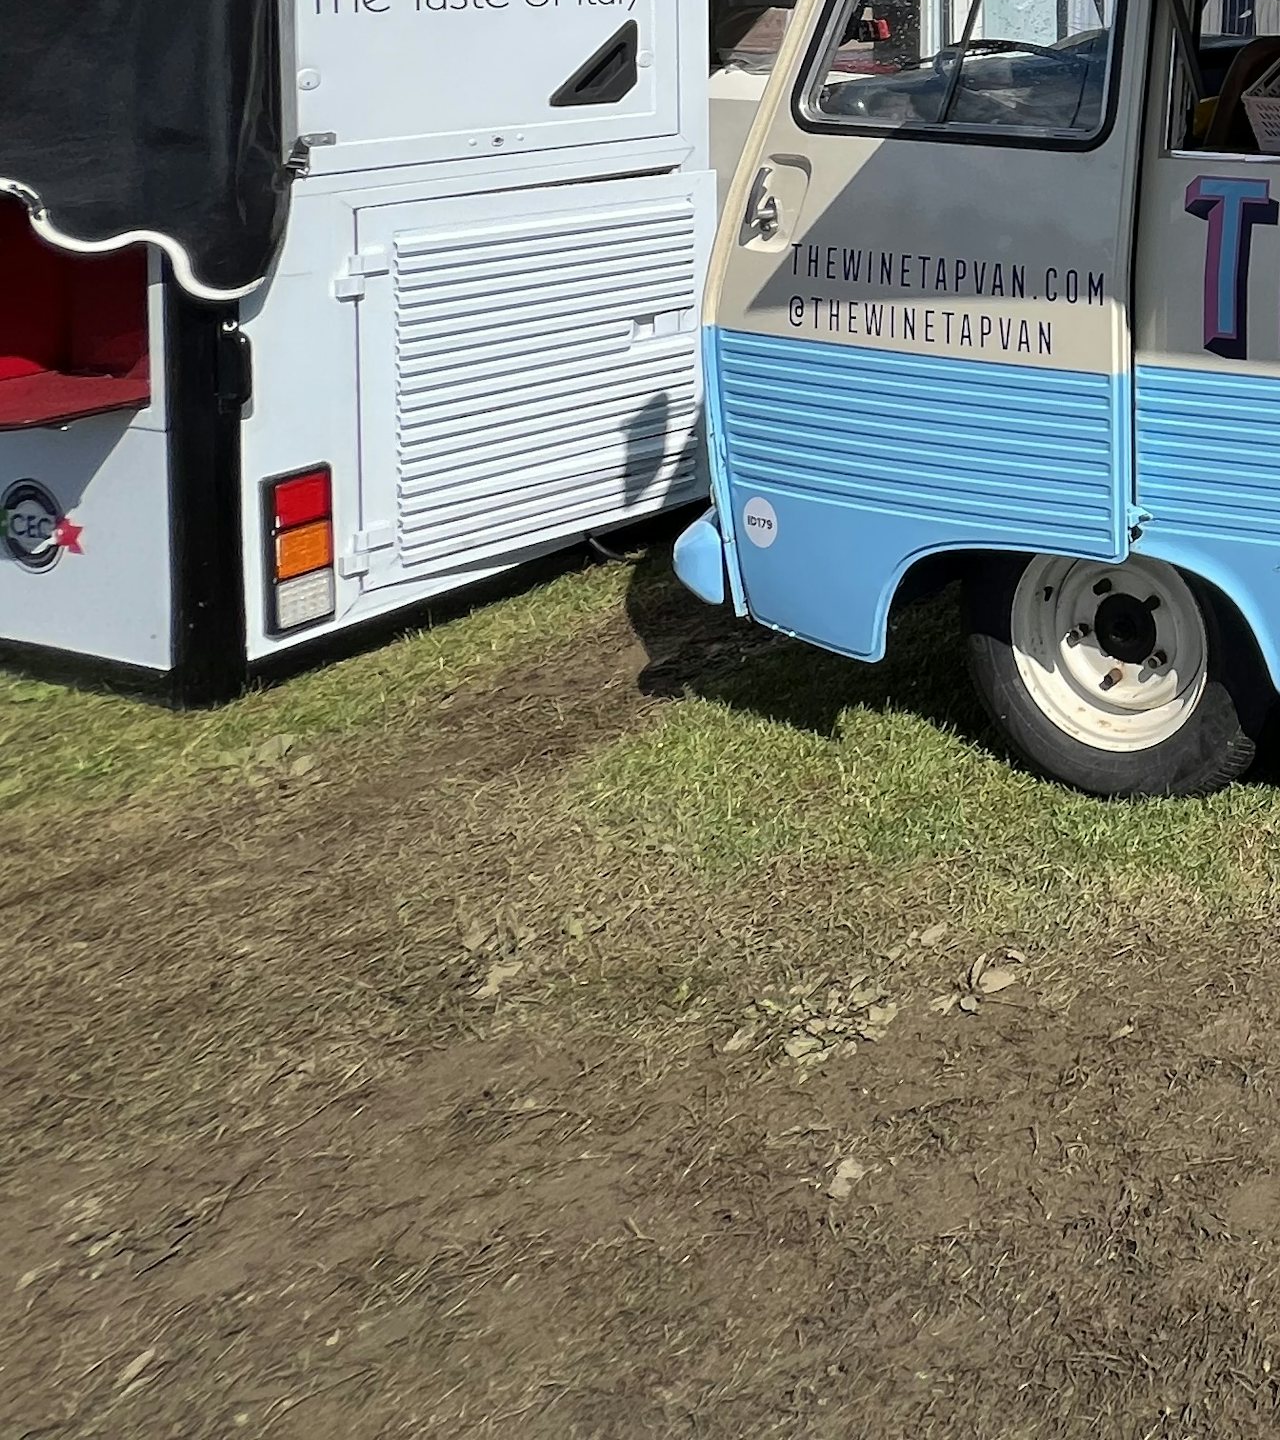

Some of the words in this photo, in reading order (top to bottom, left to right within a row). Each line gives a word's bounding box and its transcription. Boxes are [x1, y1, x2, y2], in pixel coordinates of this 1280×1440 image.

[791, 243, 1105, 306] THEWINETAPVAN.COM
[788, 295, 1053, 356] @THEWINETAPVAN
[747, 515, 773, 530] ID179
